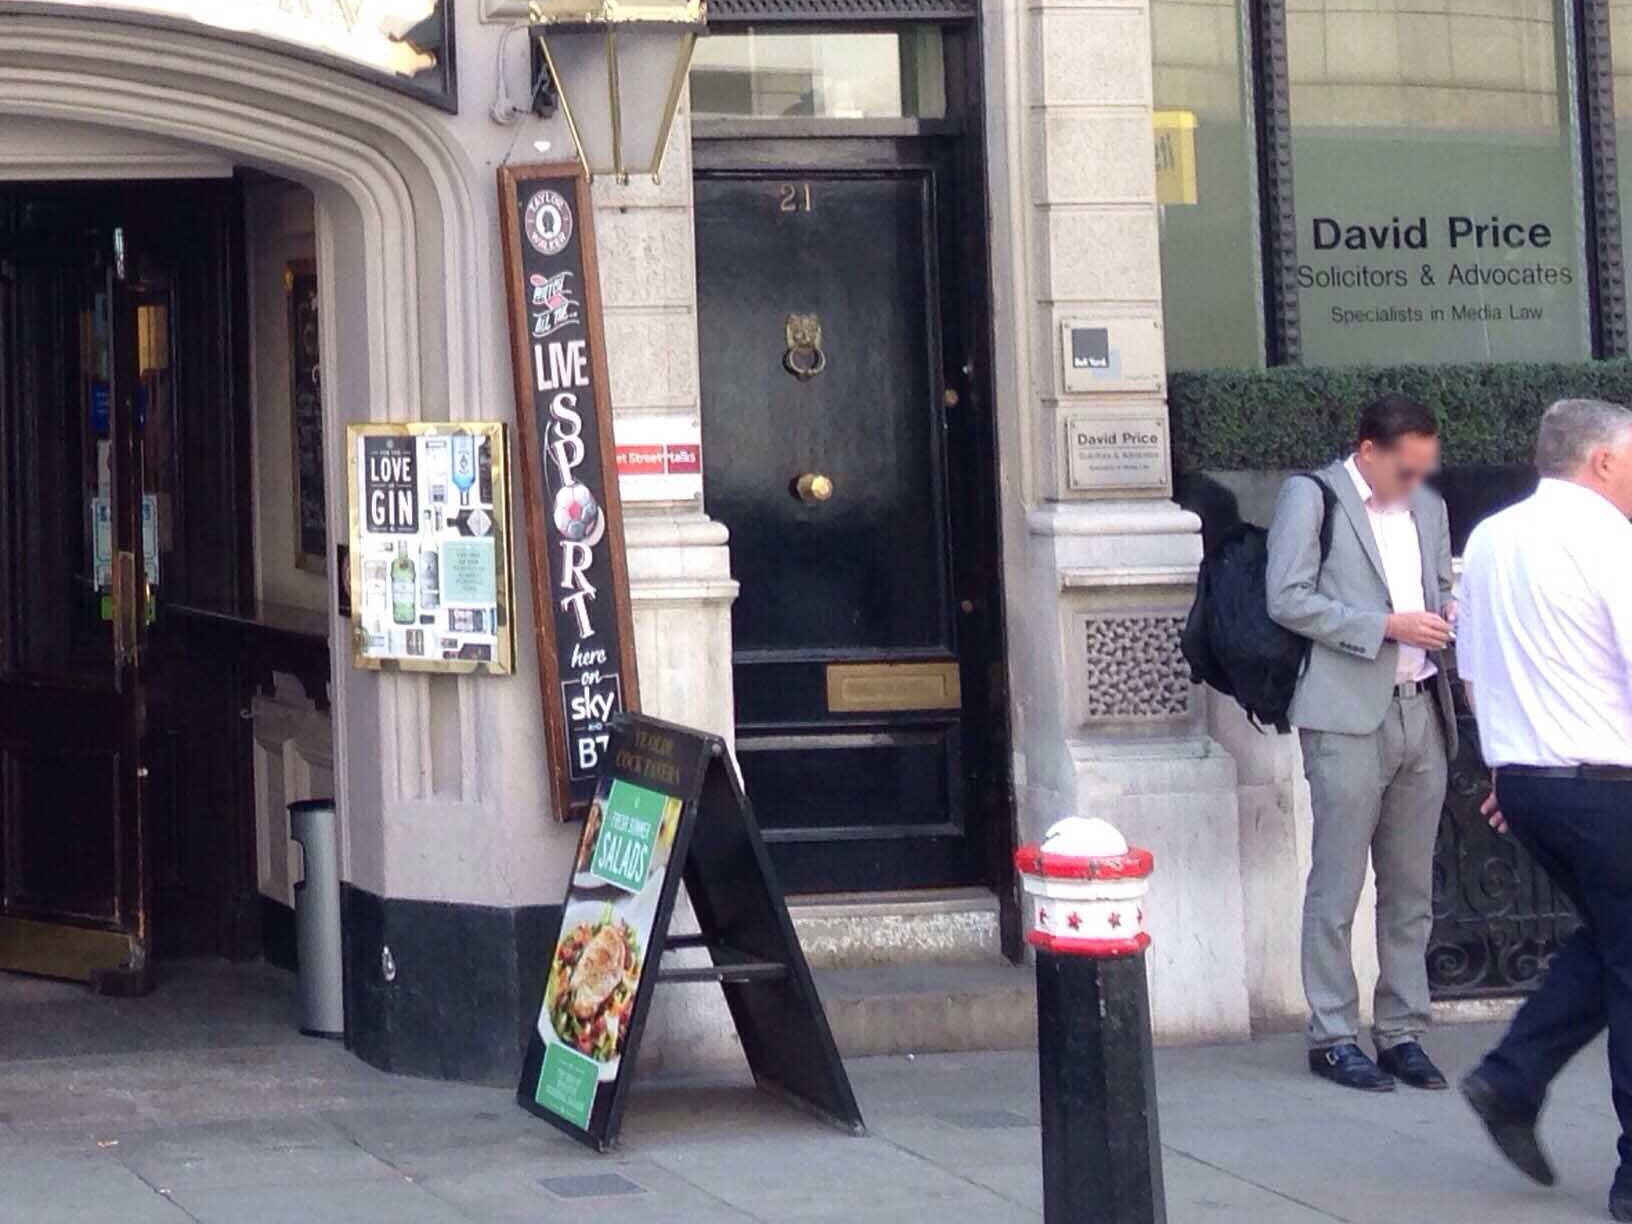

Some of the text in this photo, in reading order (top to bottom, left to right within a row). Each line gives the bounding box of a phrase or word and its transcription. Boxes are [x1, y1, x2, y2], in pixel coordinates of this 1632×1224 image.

[528, 192, 565, 211] TAYLOR
[781, 183, 811, 211] 21
[531, 231, 567, 251] WALKER
[1313, 217, 1551, 250] David Price
[1297, 263, 1573, 288] Solicitors & Advocates
[1331, 304, 1544, 324] Specialists in Media Law
[534, 340, 590, 391] LIVE
[1078, 432, 1158, 446] David Price
[370, 457, 412, 482] LOVE
[371, 489, 413, 526] GIN
[571, 644, 607, 668] here
[581, 669, 602, 686] on
[571, 686, 615, 723] sky
[598, 831, 649, 882] SALADS
